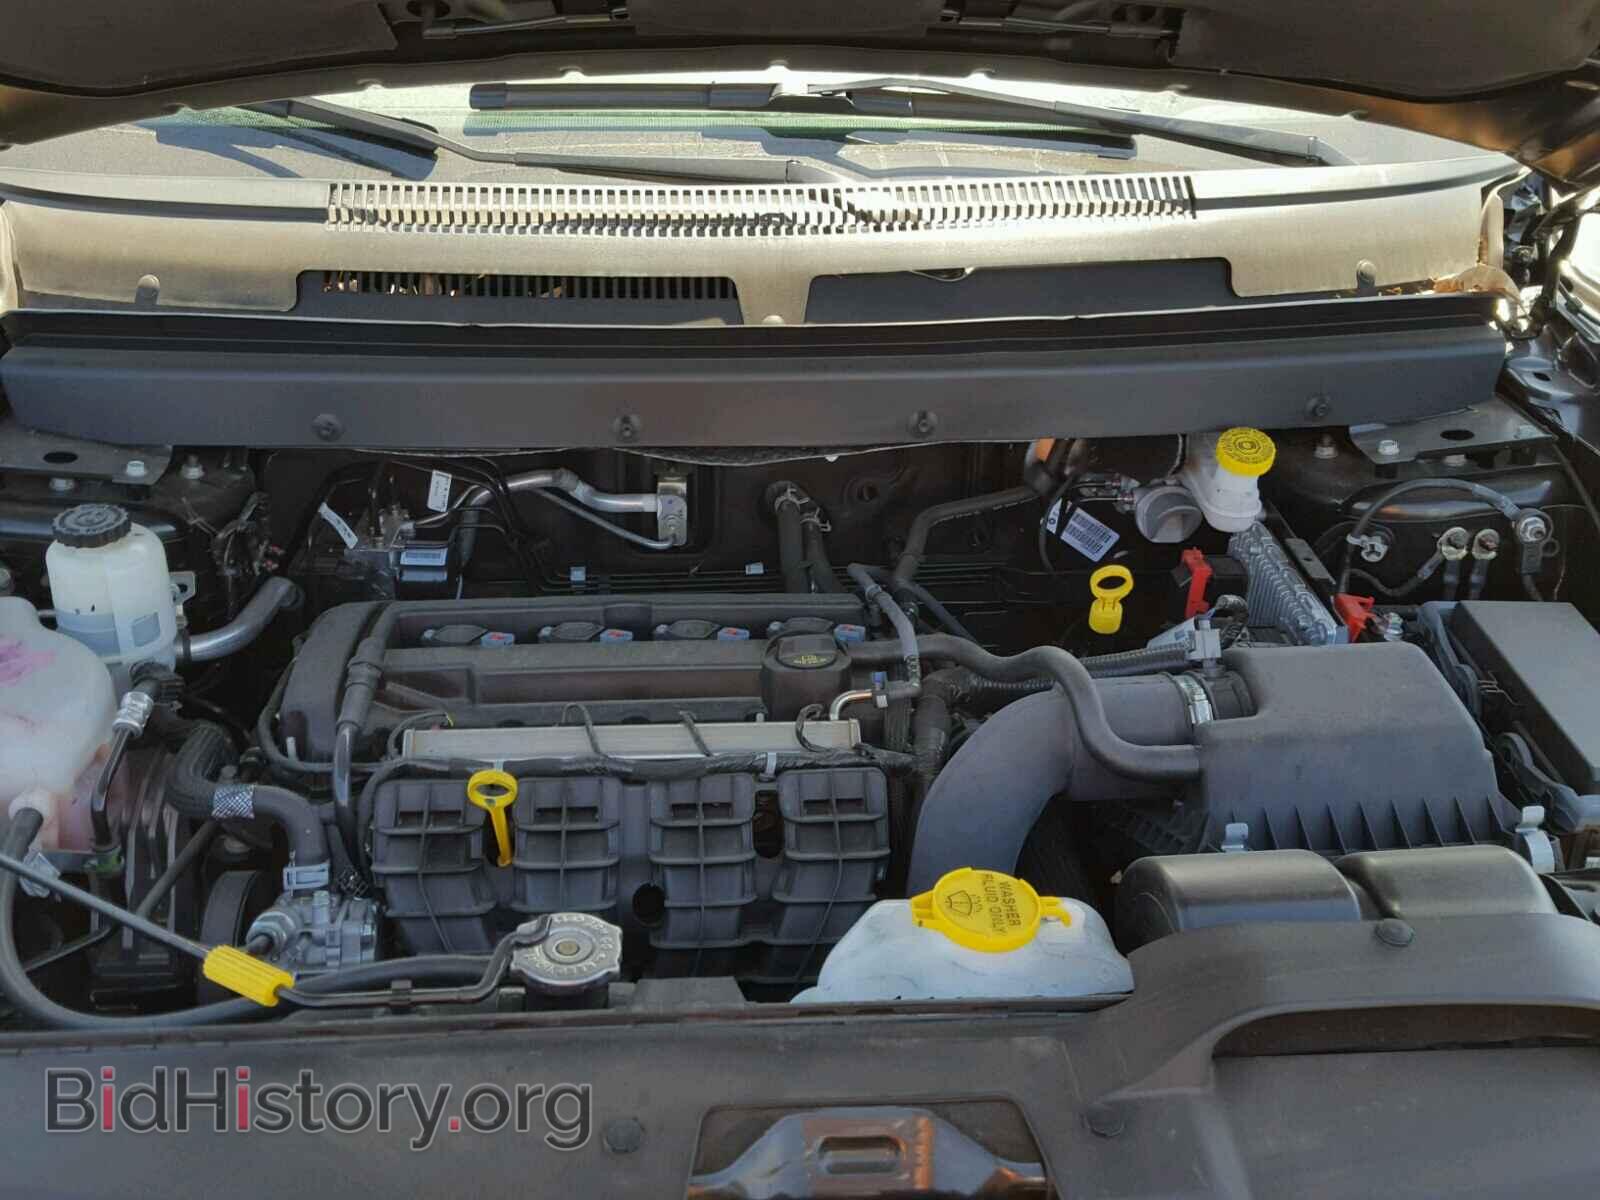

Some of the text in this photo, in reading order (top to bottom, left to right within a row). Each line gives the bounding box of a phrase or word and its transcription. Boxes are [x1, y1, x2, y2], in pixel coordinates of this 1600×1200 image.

[982, 873, 1008, 936] FLUID ONLY
[999, 880, 1021, 927] WASHER
